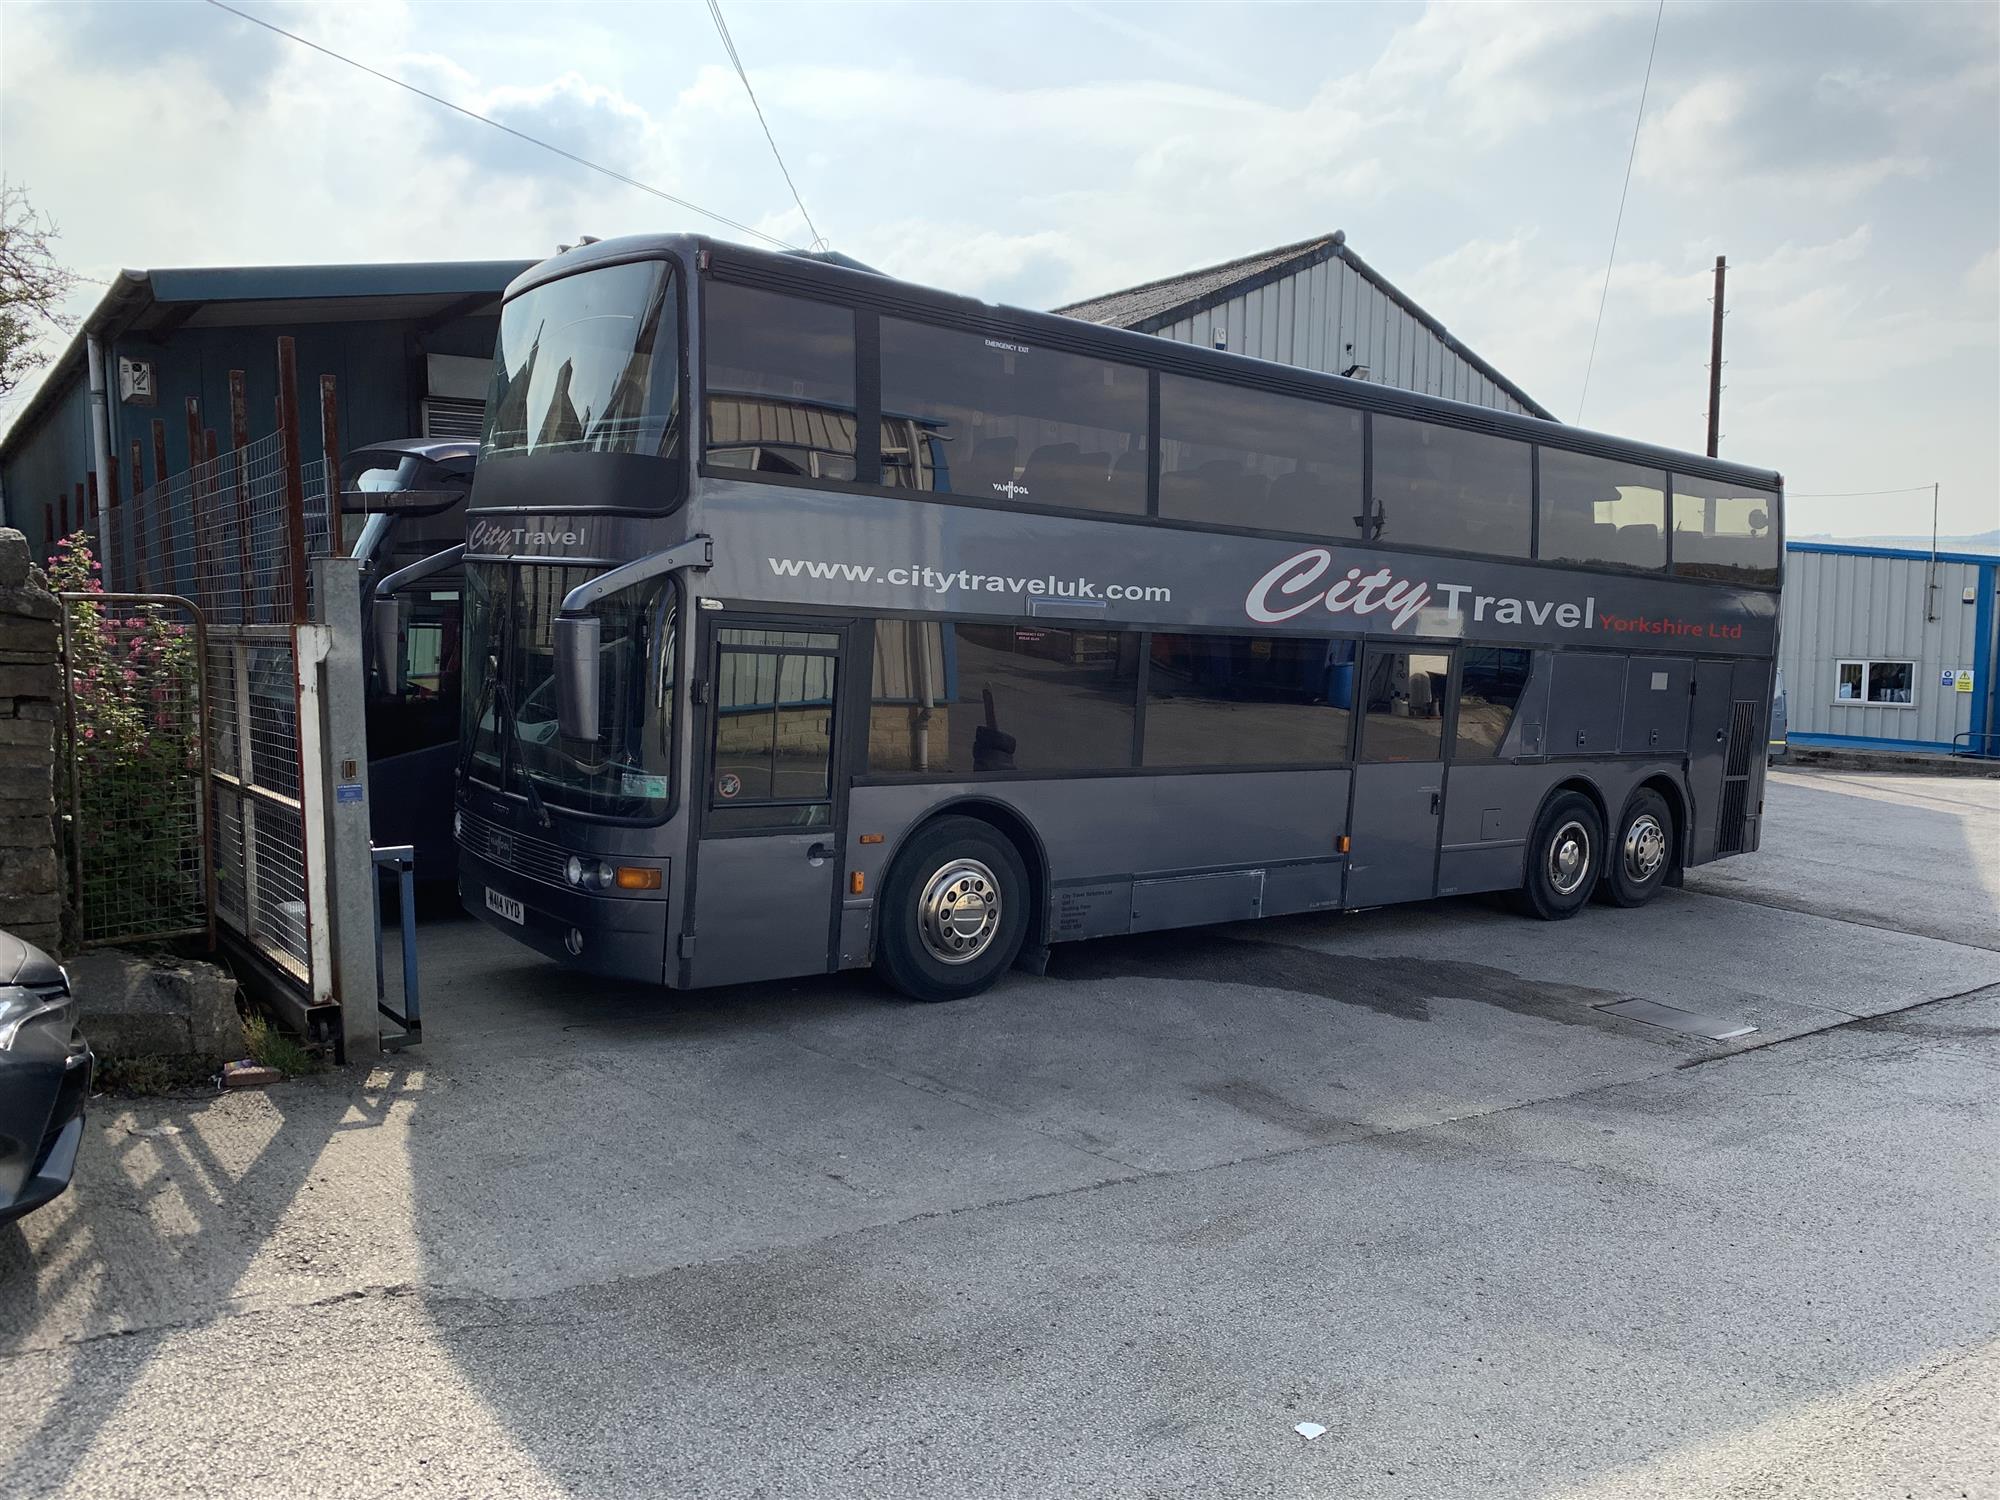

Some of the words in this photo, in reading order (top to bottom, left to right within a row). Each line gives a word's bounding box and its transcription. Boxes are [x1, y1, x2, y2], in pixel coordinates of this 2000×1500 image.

[985, 339, 1016, 351] EMERGENCY
[469, 520, 511, 551] City
[512, 528, 585, 546] Travel
[767, 557, 1171, 602] www.citytraveluk.com
[1245, 549, 1431, 631] City
[1437, 583, 1596, 629] Travel
[1600, 613, 1703, 637] Yorkshire
[1709, 623, 1743, 640] Ltd
